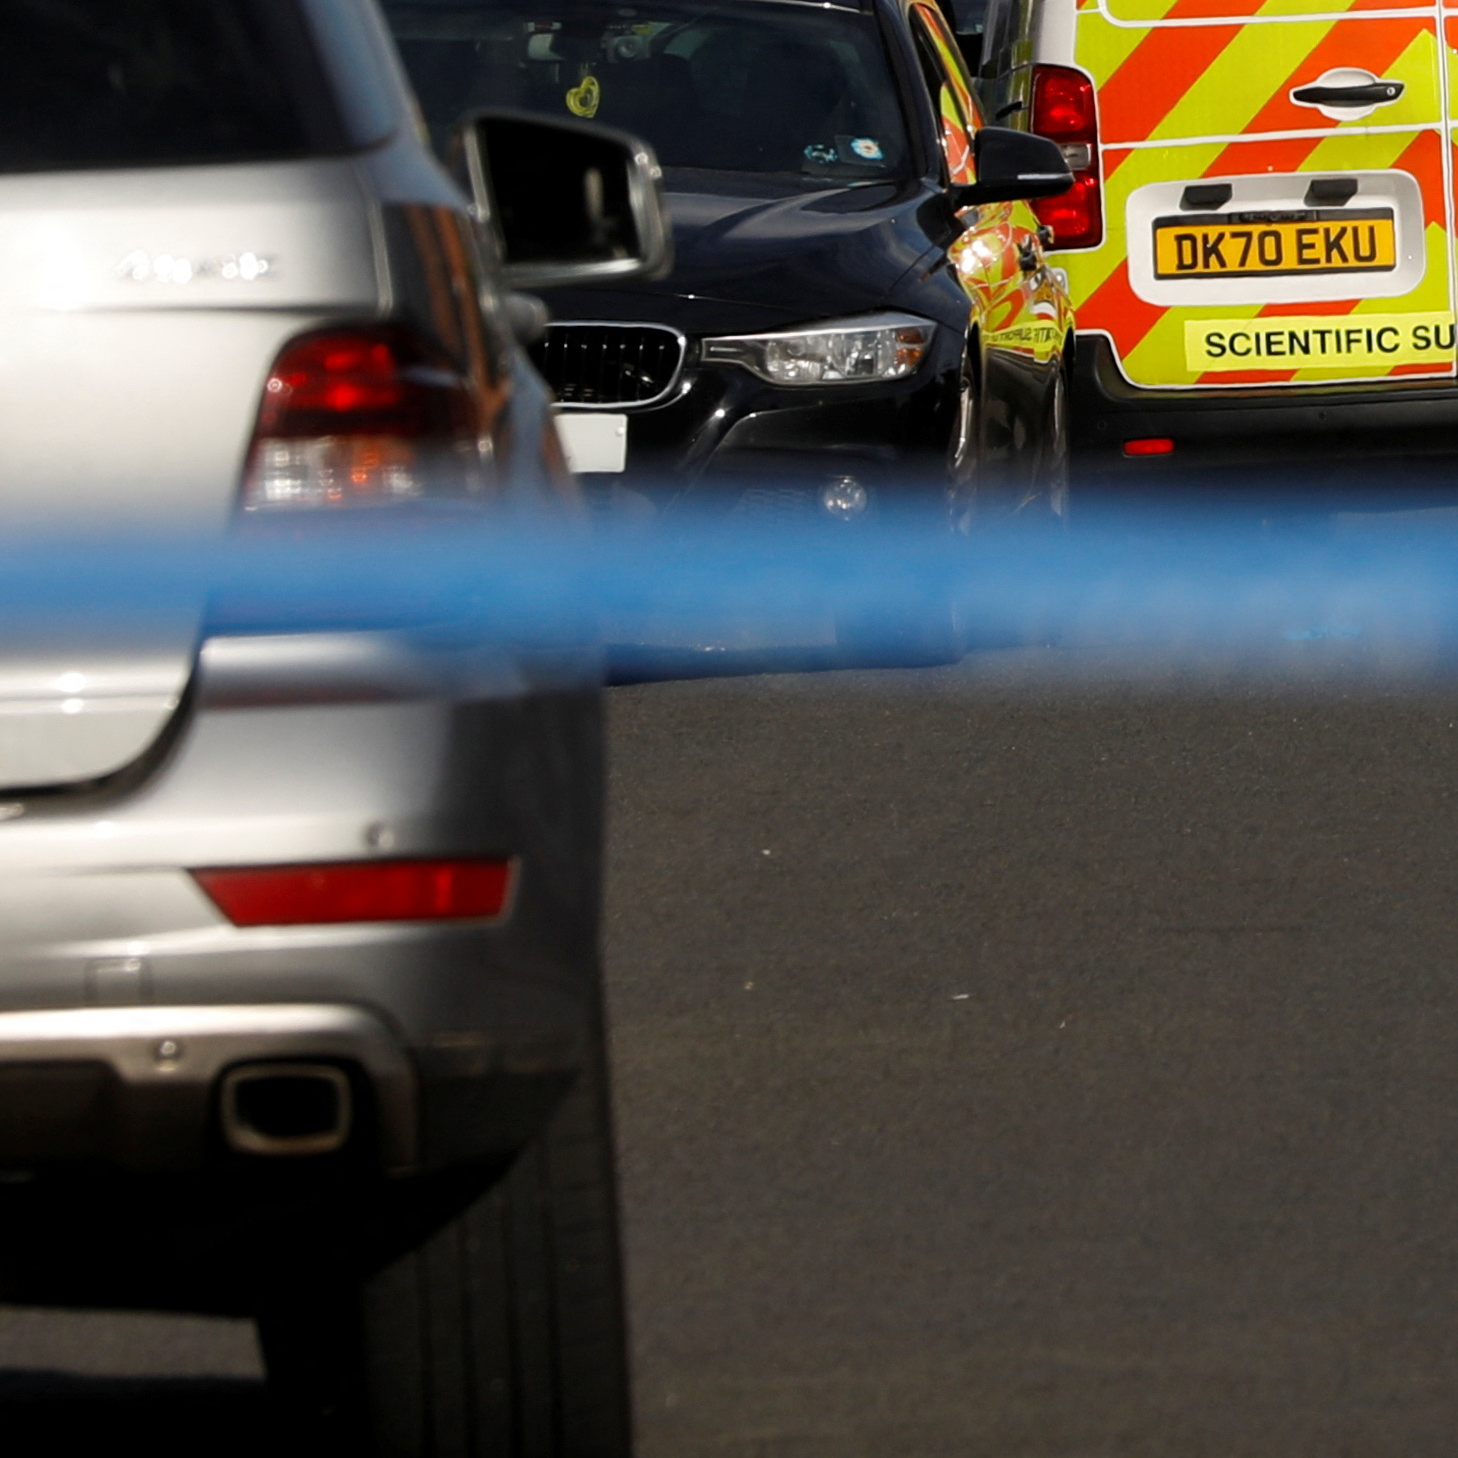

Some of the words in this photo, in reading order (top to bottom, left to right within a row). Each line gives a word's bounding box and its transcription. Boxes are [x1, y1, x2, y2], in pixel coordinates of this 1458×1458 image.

[1174, 229, 1284, 271] DK70
[1296, 225, 1378, 266] EKU
[1205, 326, 1400, 359] SCIENTIFIC
